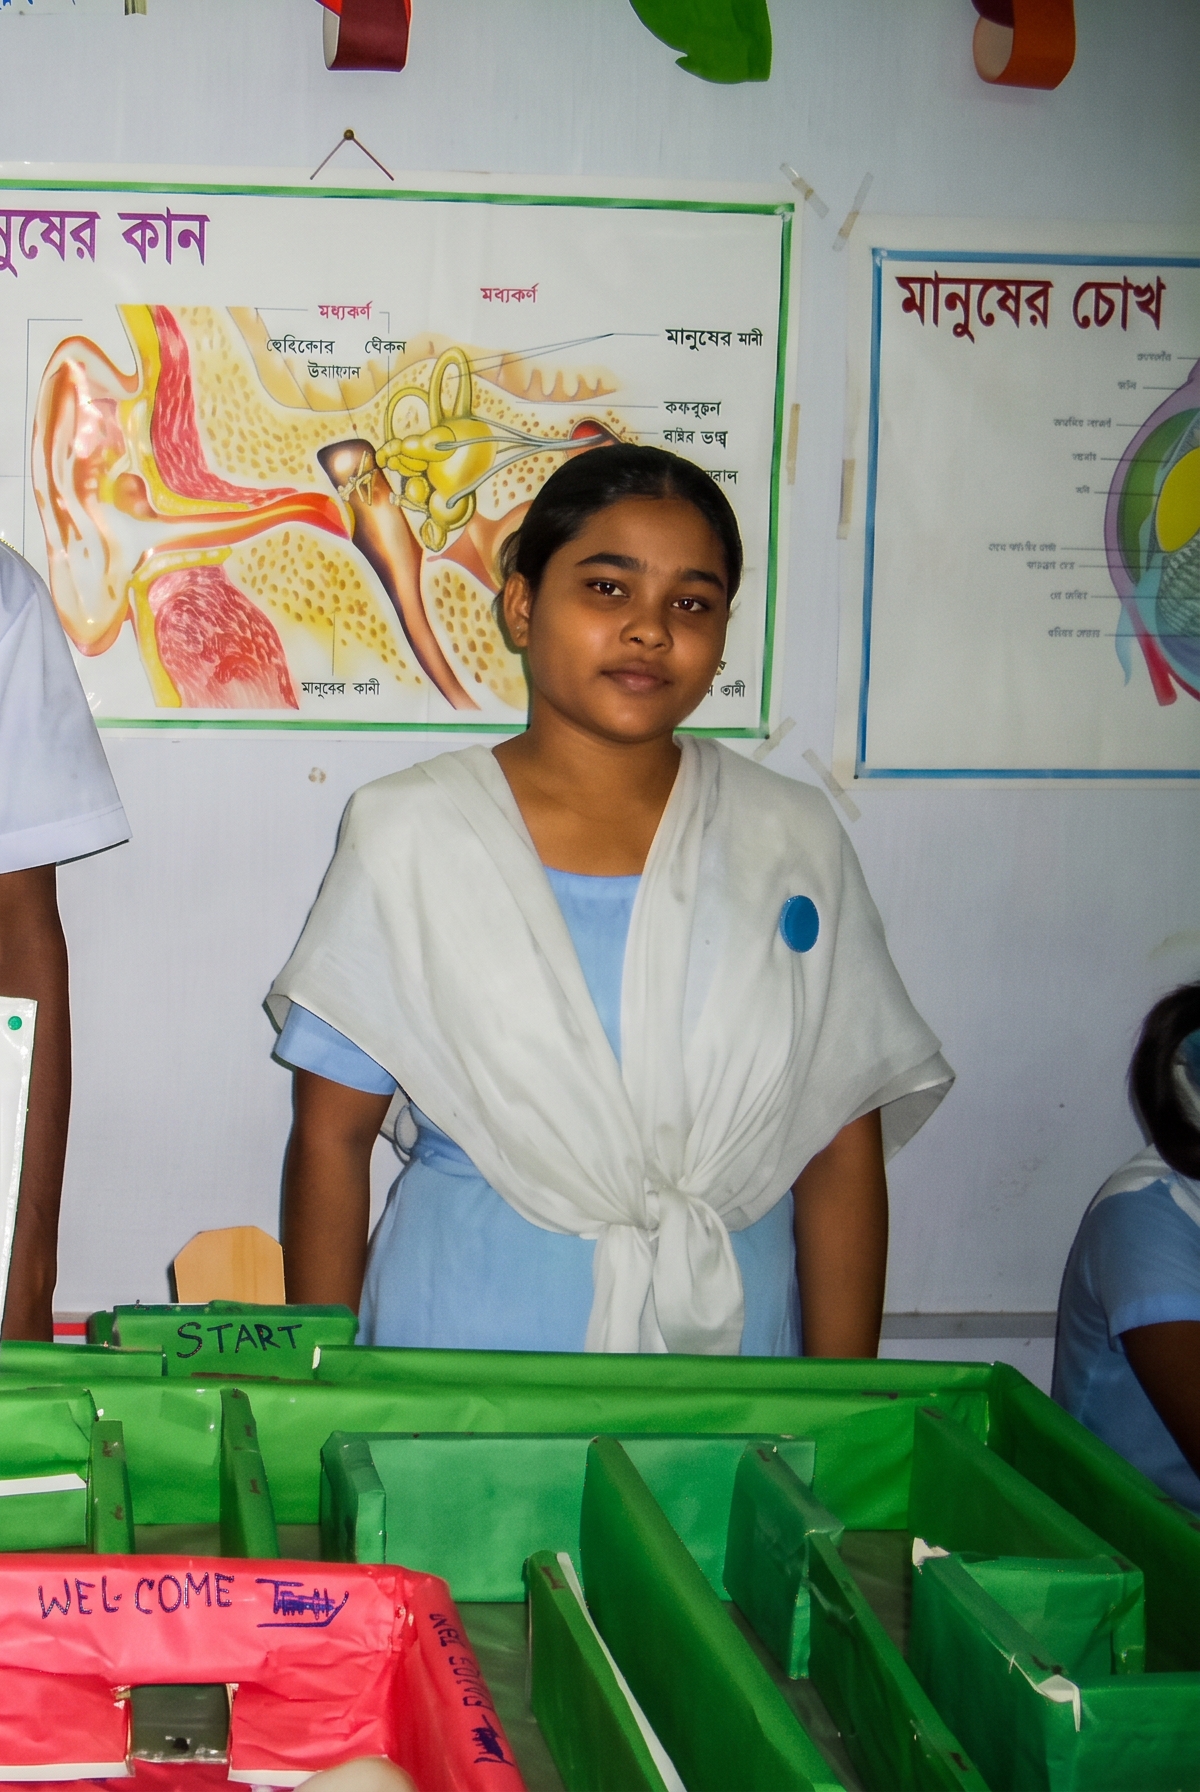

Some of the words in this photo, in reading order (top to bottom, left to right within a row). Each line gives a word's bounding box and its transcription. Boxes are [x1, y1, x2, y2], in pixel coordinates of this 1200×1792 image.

[117, 206, 211, 266] কান
[895, 270, 1054, 344] মানুষের
[1072, 275, 1167, 332] চোখ
[665, 327, 732, 351] মানুষের
[176, 1321, 302, 1358] START
